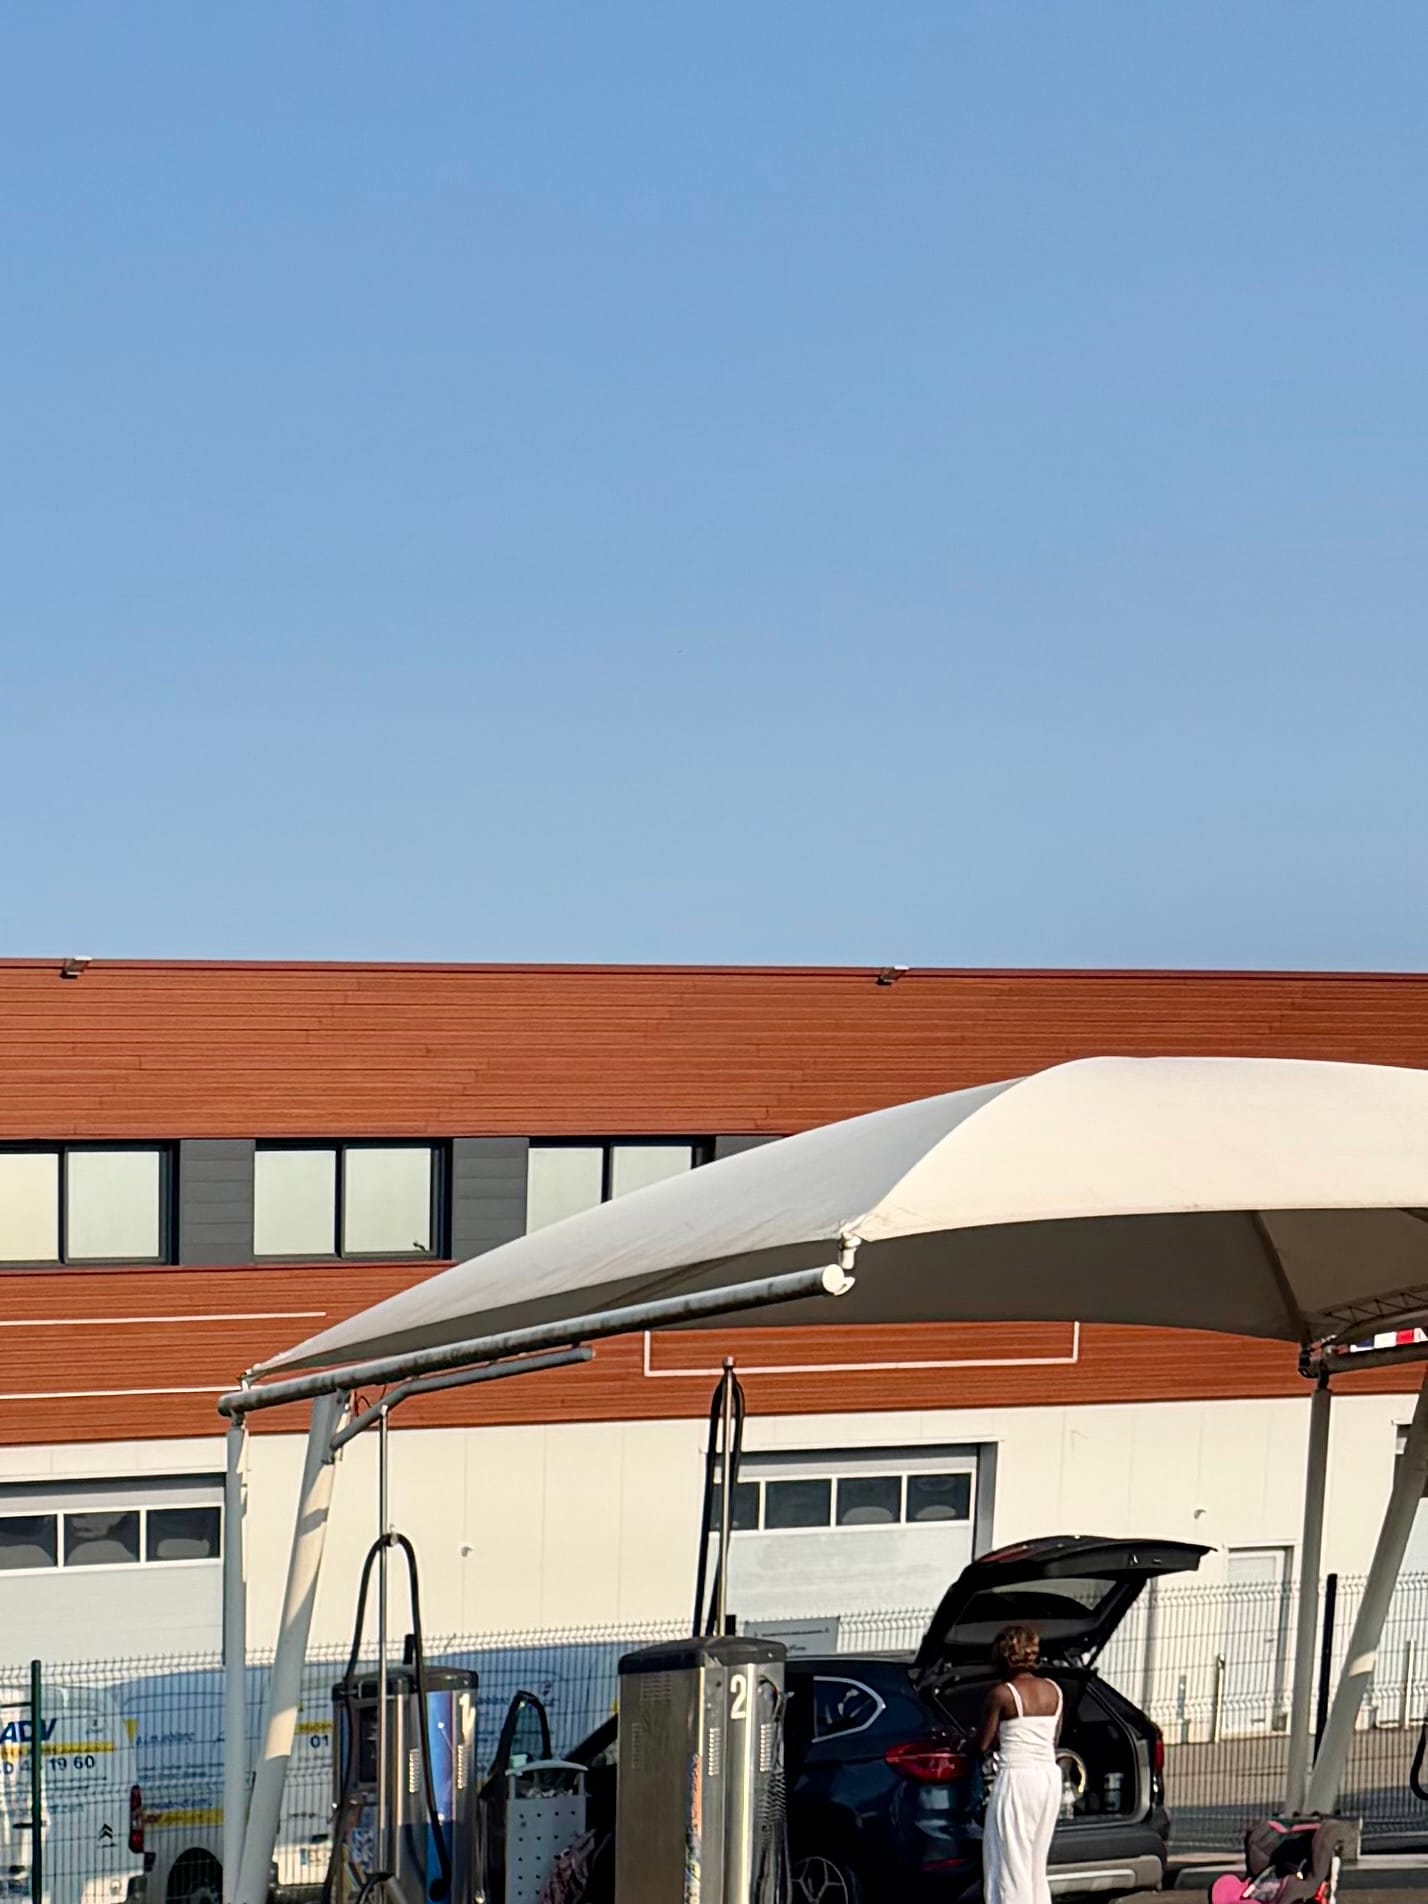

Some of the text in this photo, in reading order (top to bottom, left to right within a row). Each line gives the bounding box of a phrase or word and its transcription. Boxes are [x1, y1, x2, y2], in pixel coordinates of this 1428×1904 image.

[730, 1674, 746, 1720] 2
[310, 1734, 329, 1749] 01
[49, 1757, 67, 1771] 19
[74, 1755, 95, 1769] 60
